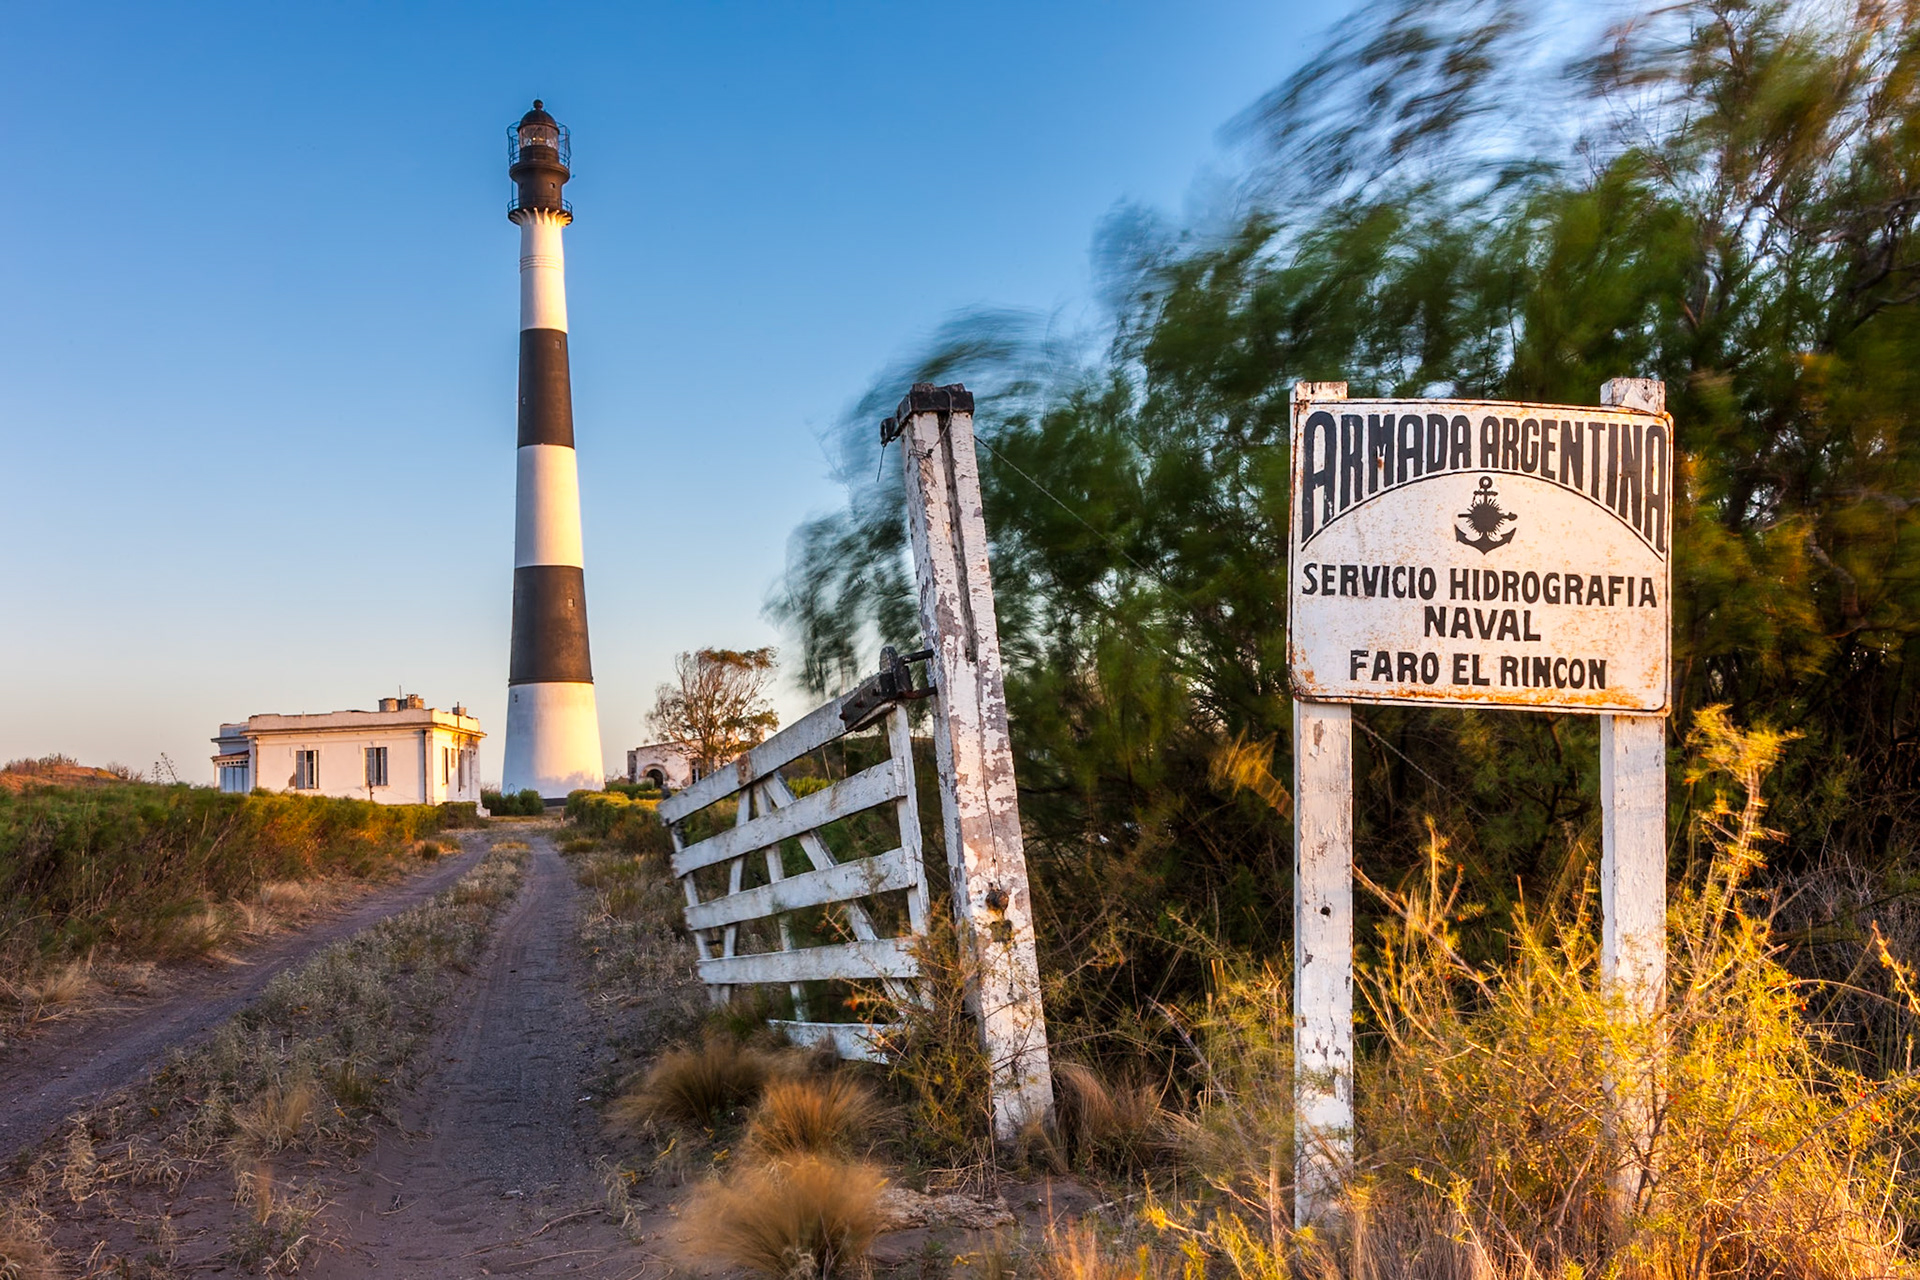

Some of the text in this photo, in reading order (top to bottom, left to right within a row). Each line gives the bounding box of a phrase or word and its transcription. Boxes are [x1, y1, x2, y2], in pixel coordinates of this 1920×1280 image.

[1301, 411, 1667, 553] ARMADA ARGENTINA
[1301, 563, 1658, 608] SERVICIO HIDROGRAFIA
[1424, 606, 1541, 642] NAVAL
[1350, 649, 1608, 690] FARO EL RINCON
